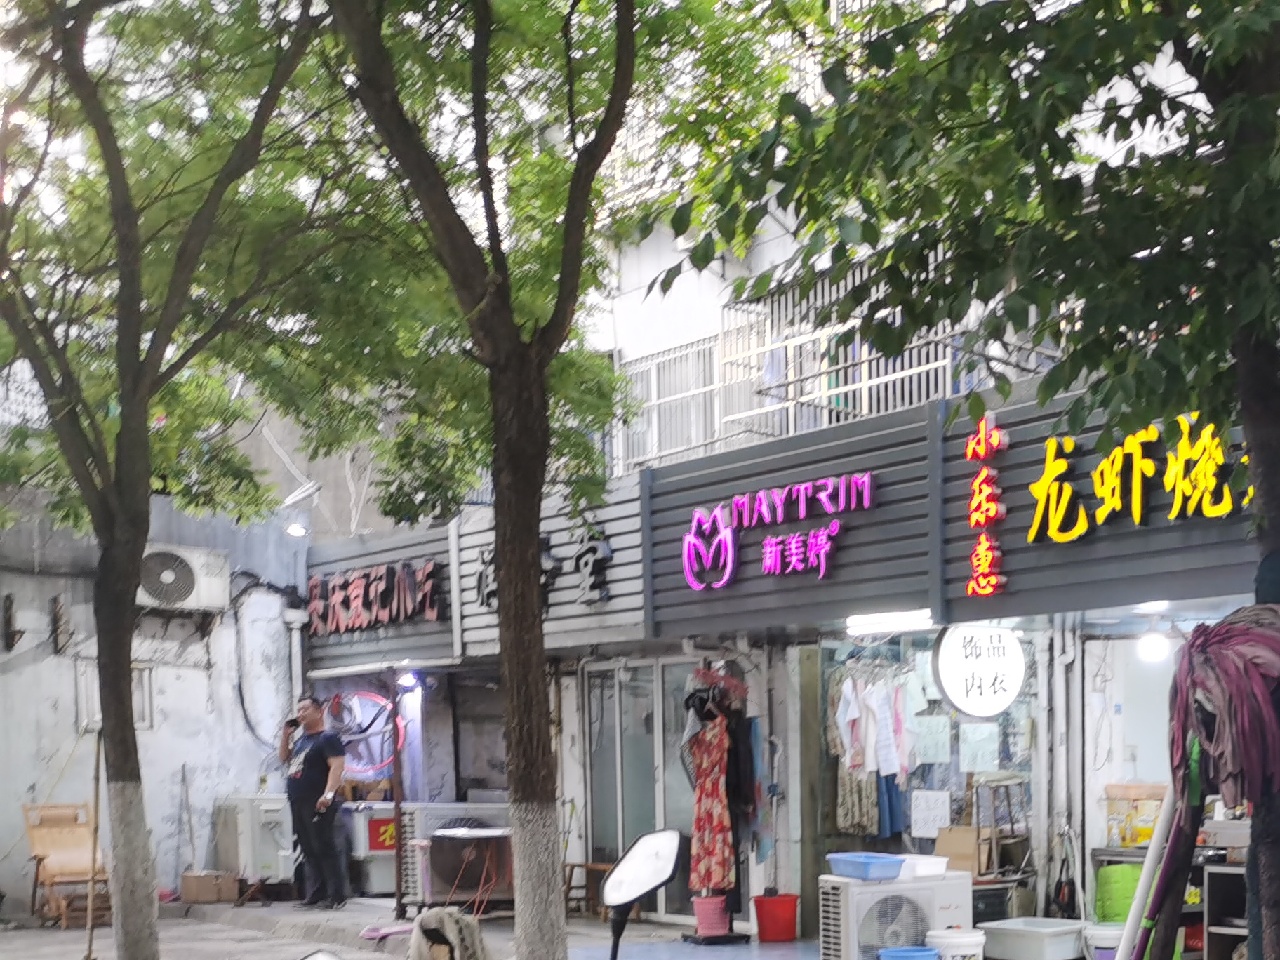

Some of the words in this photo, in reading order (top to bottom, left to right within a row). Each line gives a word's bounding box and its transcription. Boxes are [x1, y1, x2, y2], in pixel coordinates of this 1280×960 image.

[732, 471, 872, 529] MAYTRIM
[965, 415, 1004, 597] 小乐惠
[761, 526, 832, 581] 新美婷
